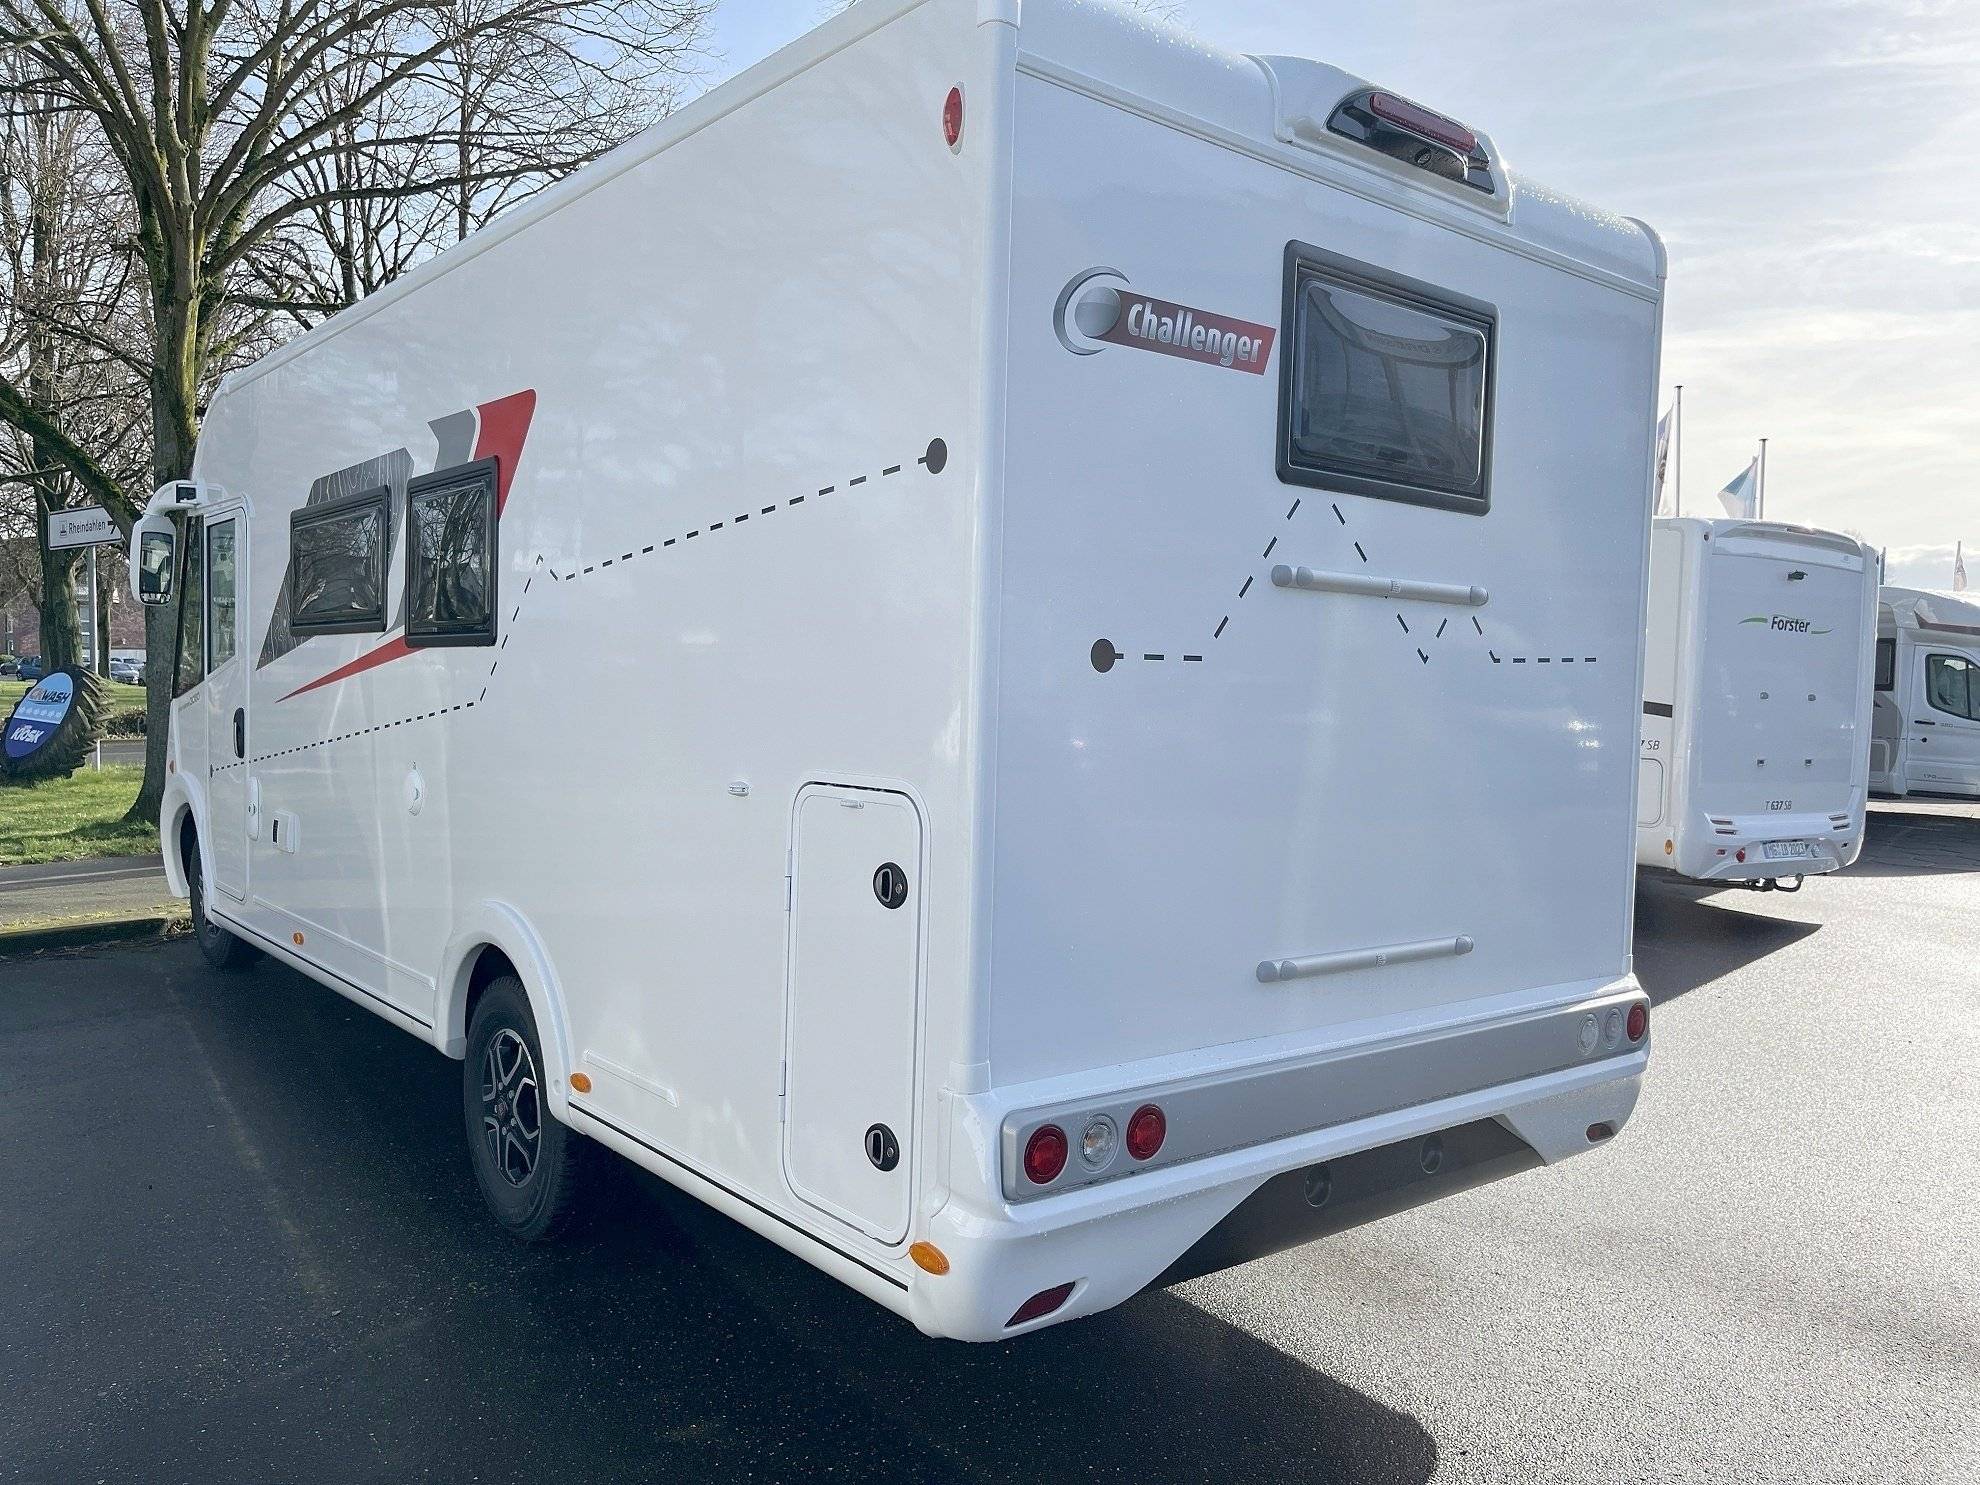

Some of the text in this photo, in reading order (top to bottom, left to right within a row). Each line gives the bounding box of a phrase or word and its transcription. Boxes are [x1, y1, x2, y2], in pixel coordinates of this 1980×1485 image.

[1127, 302, 1263, 367] Challenger
[68, 519, 106, 535] Rheindahlen
[1771, 616, 1811, 633] Forster
[41, 690, 71, 703] WASH
[10, 727, 44, 744] KIOSK
[1646, 740, 1660, 750] SB
[1771, 801, 1783, 810] 637
[1784, 801, 1792, 810] SB
